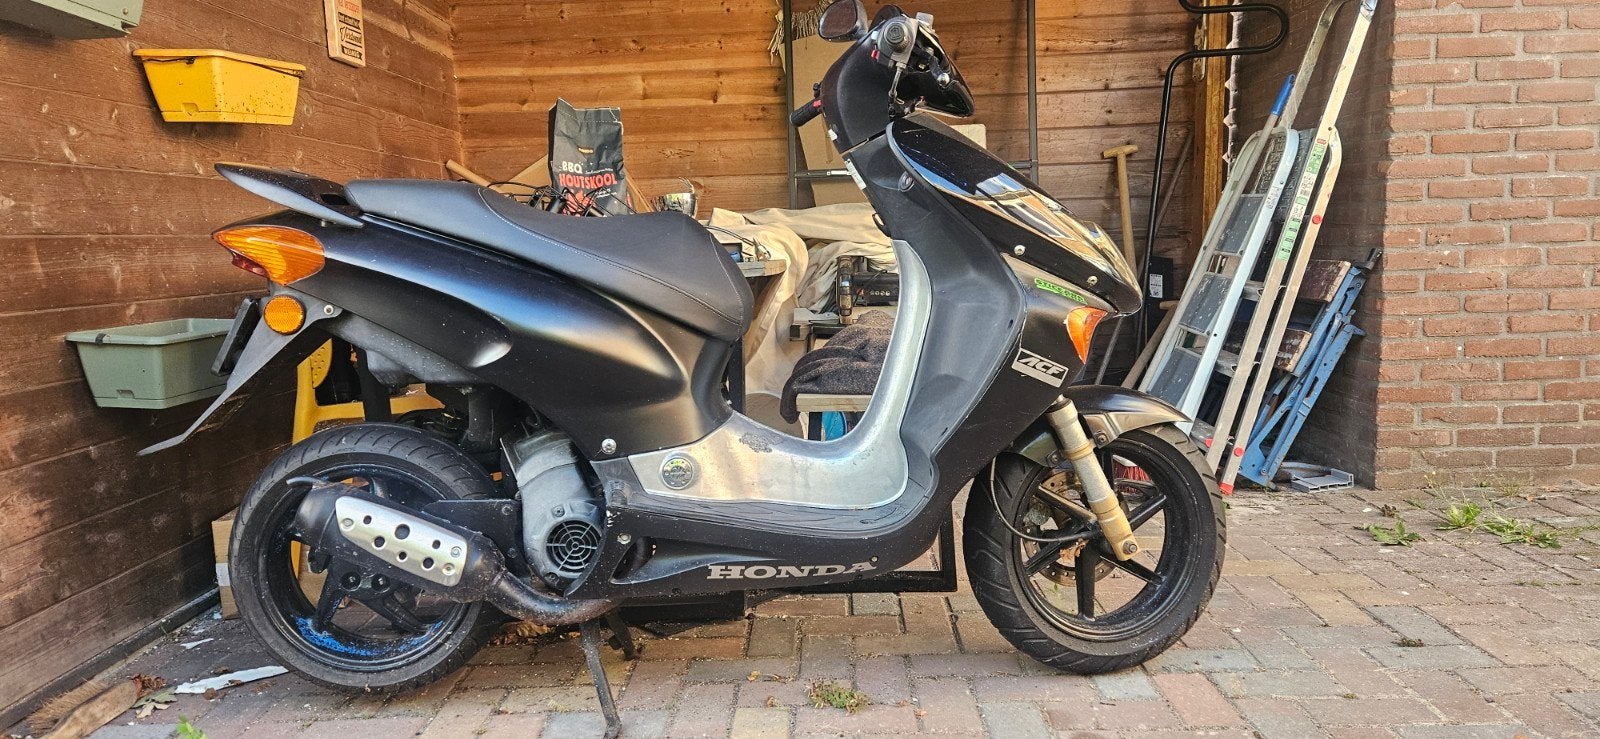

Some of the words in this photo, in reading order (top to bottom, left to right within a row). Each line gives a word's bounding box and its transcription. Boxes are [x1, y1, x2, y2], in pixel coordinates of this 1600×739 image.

[562, 161, 582, 173] BBQ
[559, 174, 617, 189] HOUTSKOOL
[1019, 357, 1064, 377] ACF
[706, 562, 877, 579] HONDA
